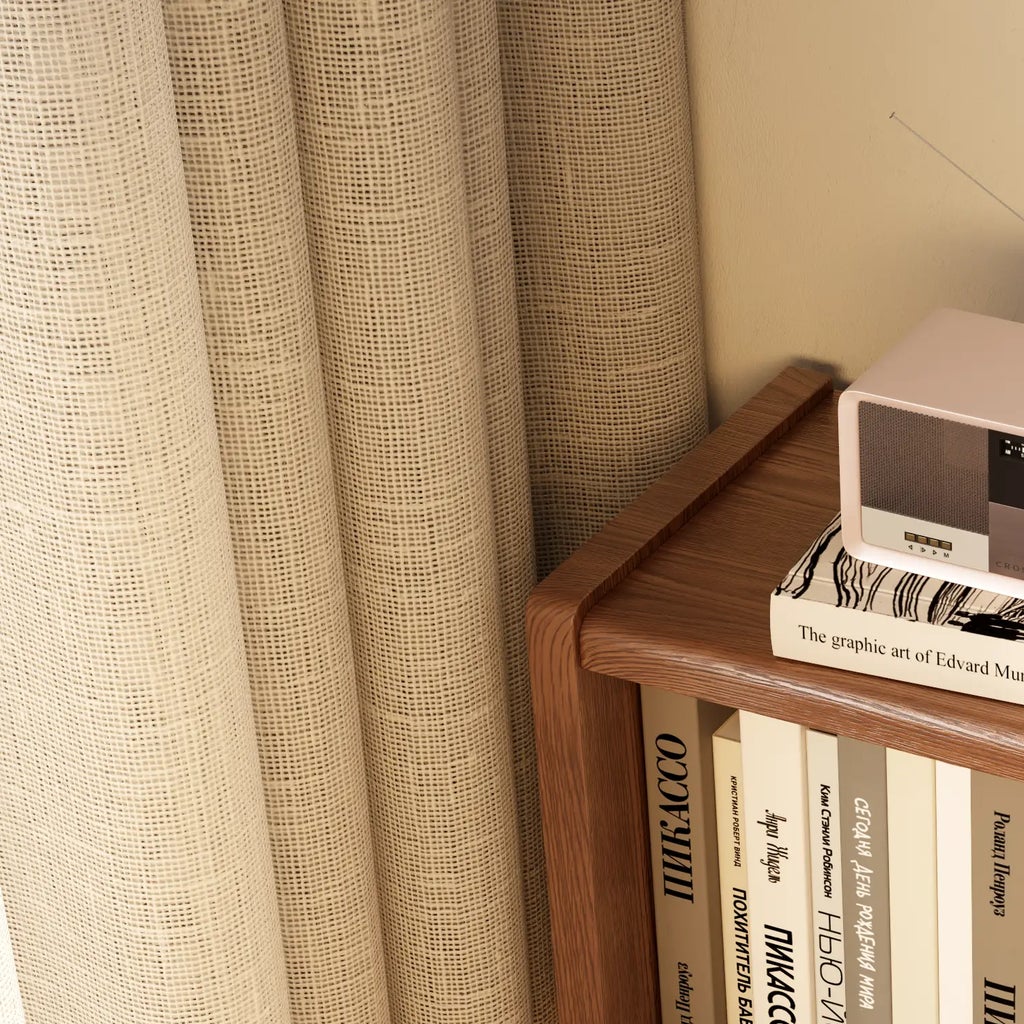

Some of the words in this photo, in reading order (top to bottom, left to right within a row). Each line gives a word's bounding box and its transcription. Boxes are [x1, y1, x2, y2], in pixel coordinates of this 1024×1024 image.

[797, 624, 827, 644] The
[831, 636, 887, 657] graphic
[890, 647, 911, 661] art
[914, 649, 934, 665] of
[936, 651, 990, 676] Edvard
[654, 732, 695, 905] ПИКАССО
[730, 775, 740, 816] КРИСТИАН
[819, 783, 832, 808] Ким
[732, 816, 741, 846] РОБЕРТ
[757, 809, 787, 839] Анри
[820, 808, 833, 848] Стэнли
[852, 797, 873, 858] СЕГОДНЯ
[991, 809, 1011, 860] Роланд
[733, 846, 742, 868] ВИНД
[760, 842, 789, 884] Жидель
[822, 848, 834, 900] Робинсон
[850, 859, 875, 899] ДЕНЬ
[989, 860, 1011, 918] Пенроуз
[731, 886, 752, 994] ПОХИТИТЕЛЬ
[853, 902, 877, 973] РОЖДЕНИЯ
[675, 961, 695, 1013] Пенроуз
[858, 973, 876, 1010] МИРА
